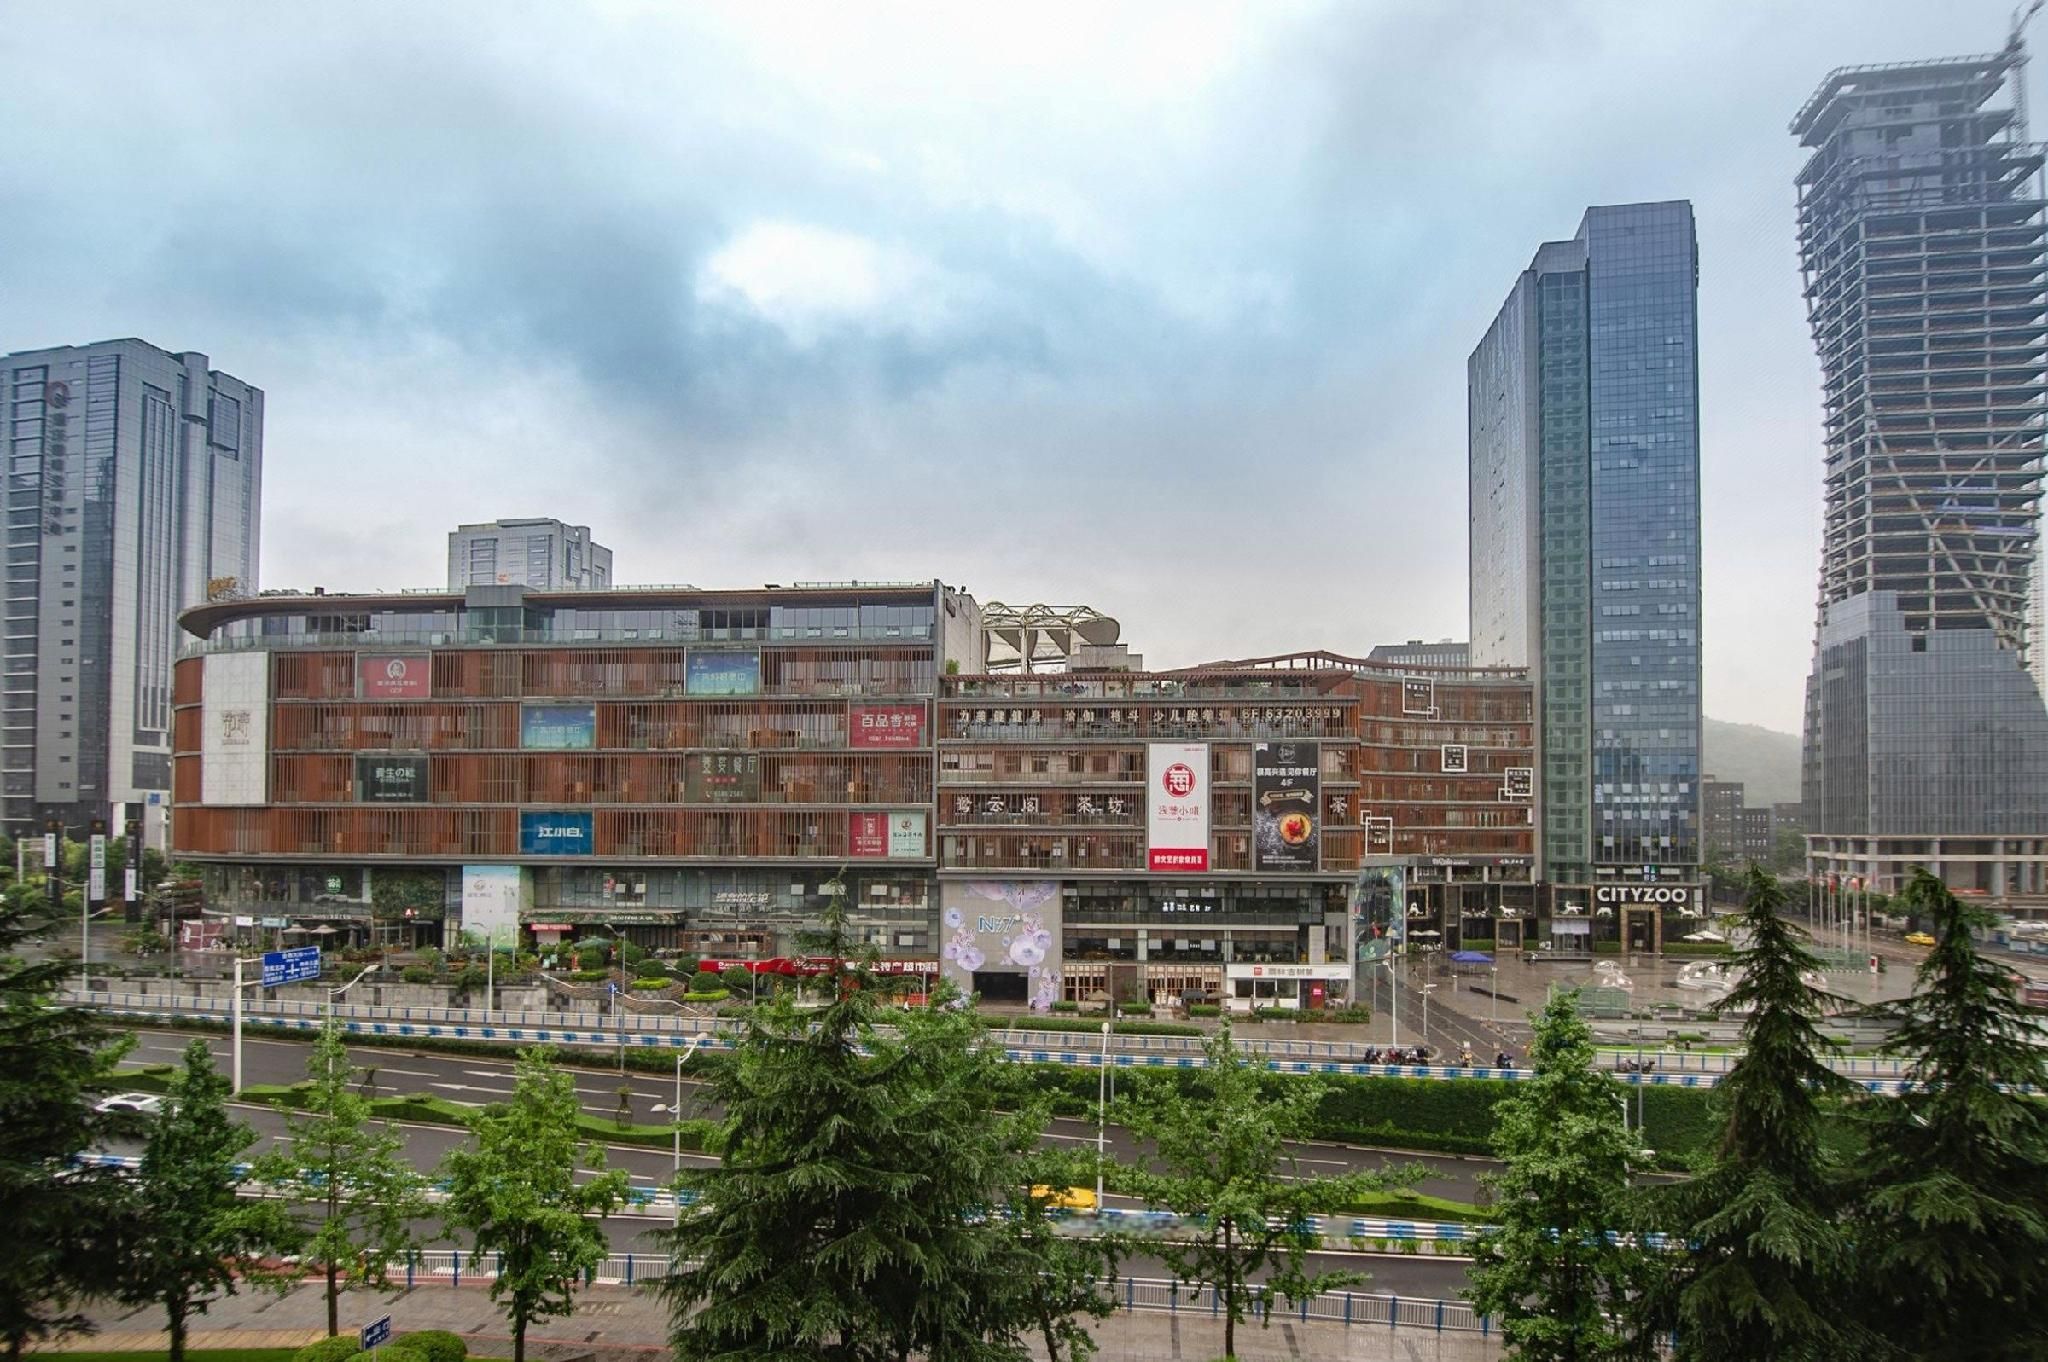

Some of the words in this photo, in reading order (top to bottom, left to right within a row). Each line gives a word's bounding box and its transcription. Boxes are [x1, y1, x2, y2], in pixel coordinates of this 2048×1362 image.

[1065, 709, 1094, 722] 瑜伽
[1111, 709, 1139, 722] 格斗
[1241, 708, 1259, 719] 6F
[1076, 796, 1124, 814] 茶坊
[1596, 887, 1687, 903] CITYZOO
